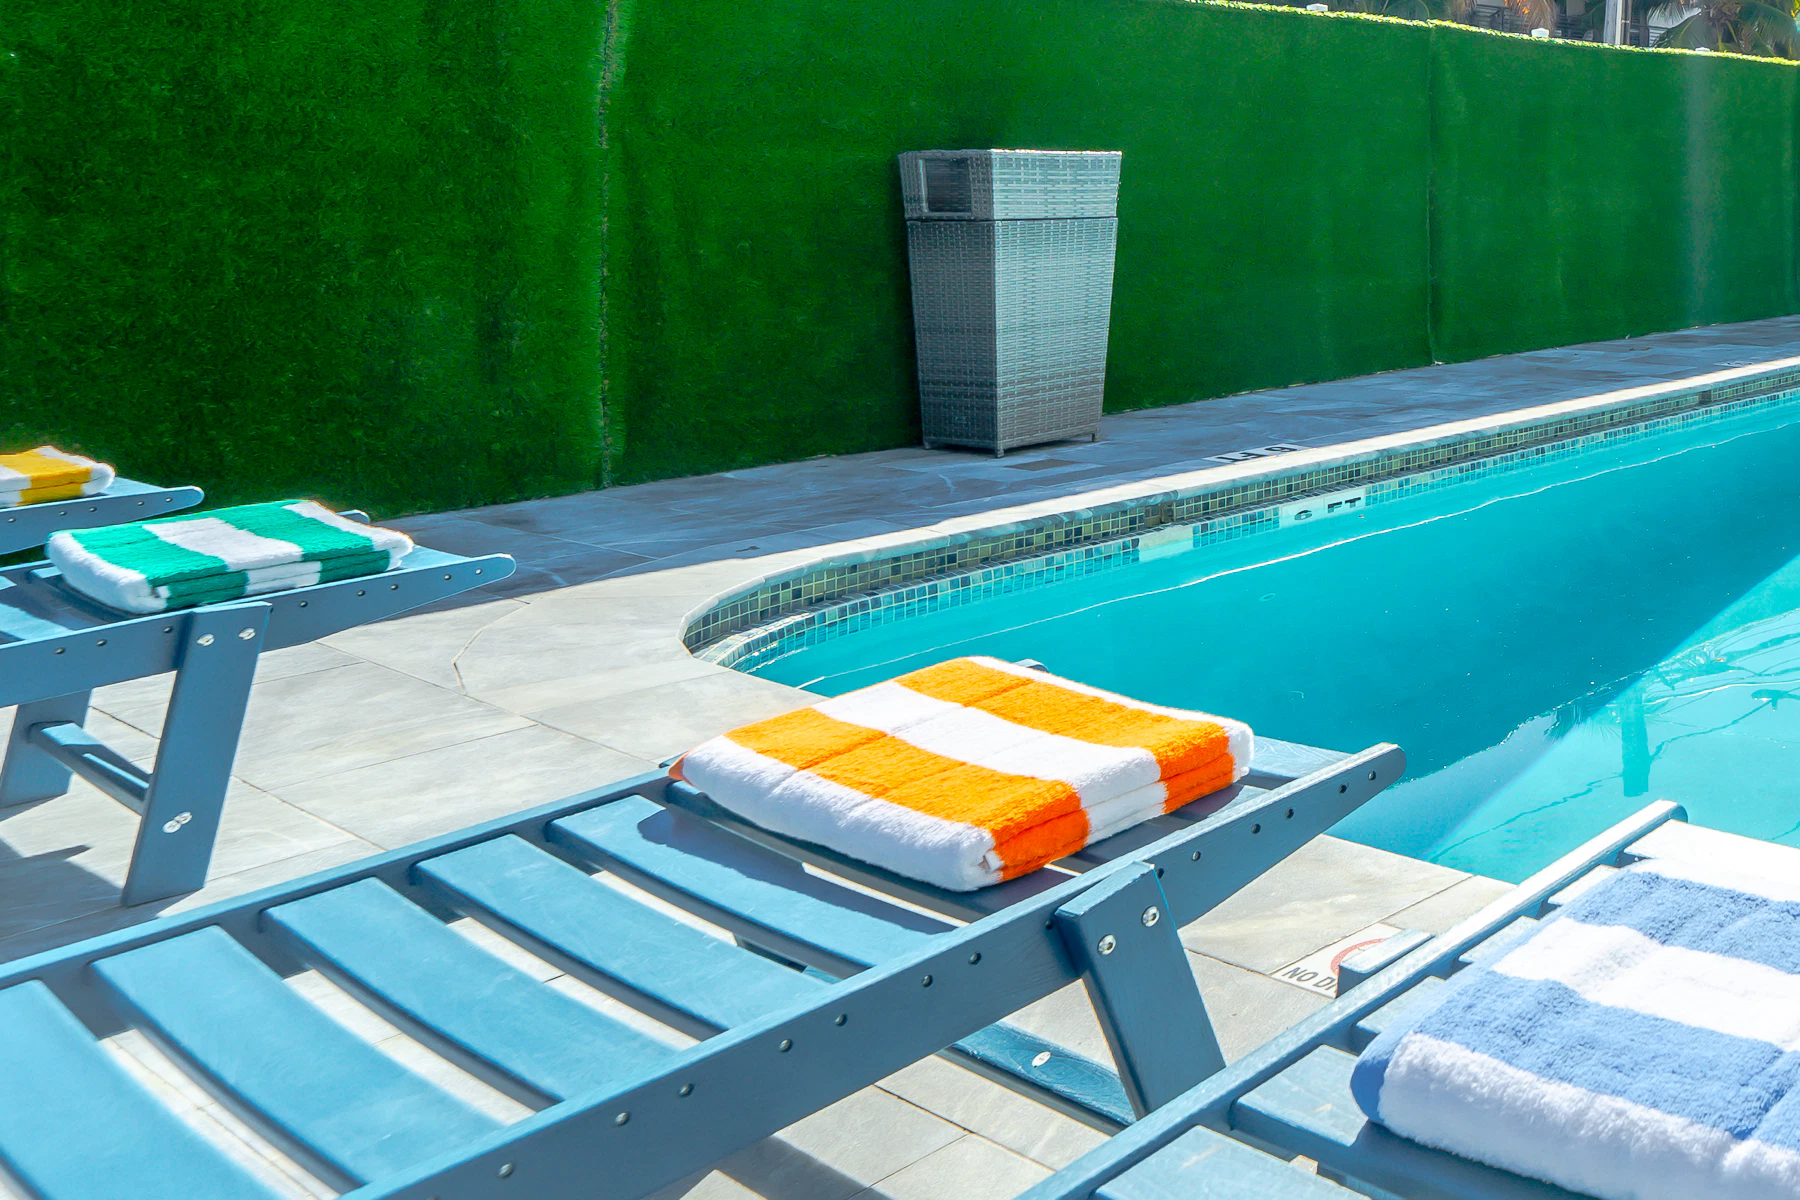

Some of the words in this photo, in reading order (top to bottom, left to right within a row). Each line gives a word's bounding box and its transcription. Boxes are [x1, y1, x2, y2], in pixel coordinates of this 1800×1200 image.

[1216, 452, 1266, 463] FT
[1294, 509, 1312, 521] 6
[1327, 497, 1361, 513] FT
[1281, 967, 1319, 982] NO
